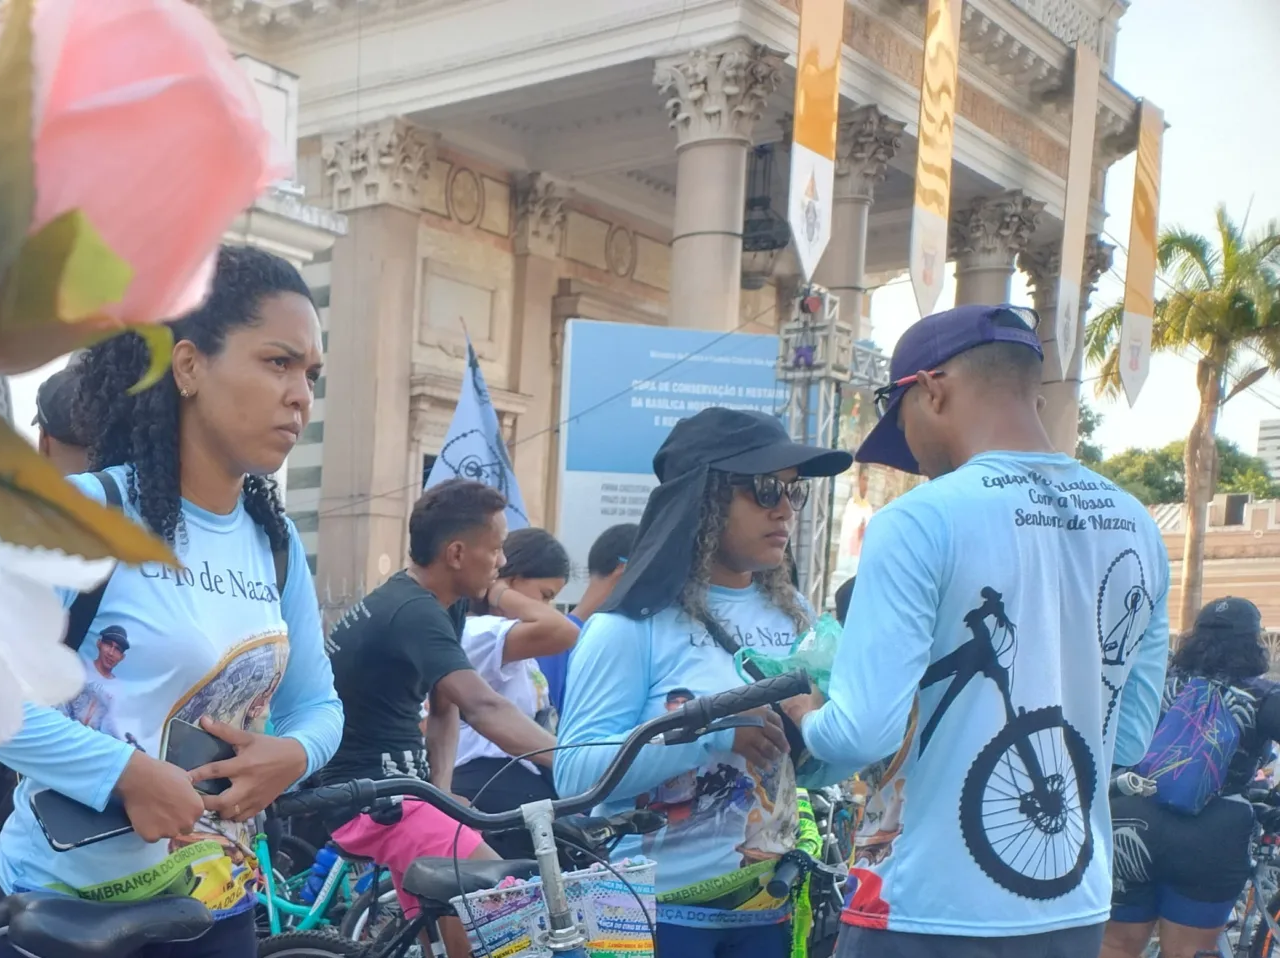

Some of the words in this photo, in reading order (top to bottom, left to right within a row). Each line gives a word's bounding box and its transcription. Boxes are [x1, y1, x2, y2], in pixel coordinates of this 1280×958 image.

[672, 382, 736, 397] CONSERVAÇÃO
[1058, 497, 1068, 508] a
[1071, 494, 1115, 510] Nossa
[1067, 515, 1086, 531] de
[200, 561, 225, 594] de
[737, 627, 754, 647] de
[757, 627, 796, 647] Naz
[160, 859, 174, 877] DO
[174, 846, 196, 865] CÍRIO
[195, 843, 207, 853] DE
[687, 910, 705, 921] DO
